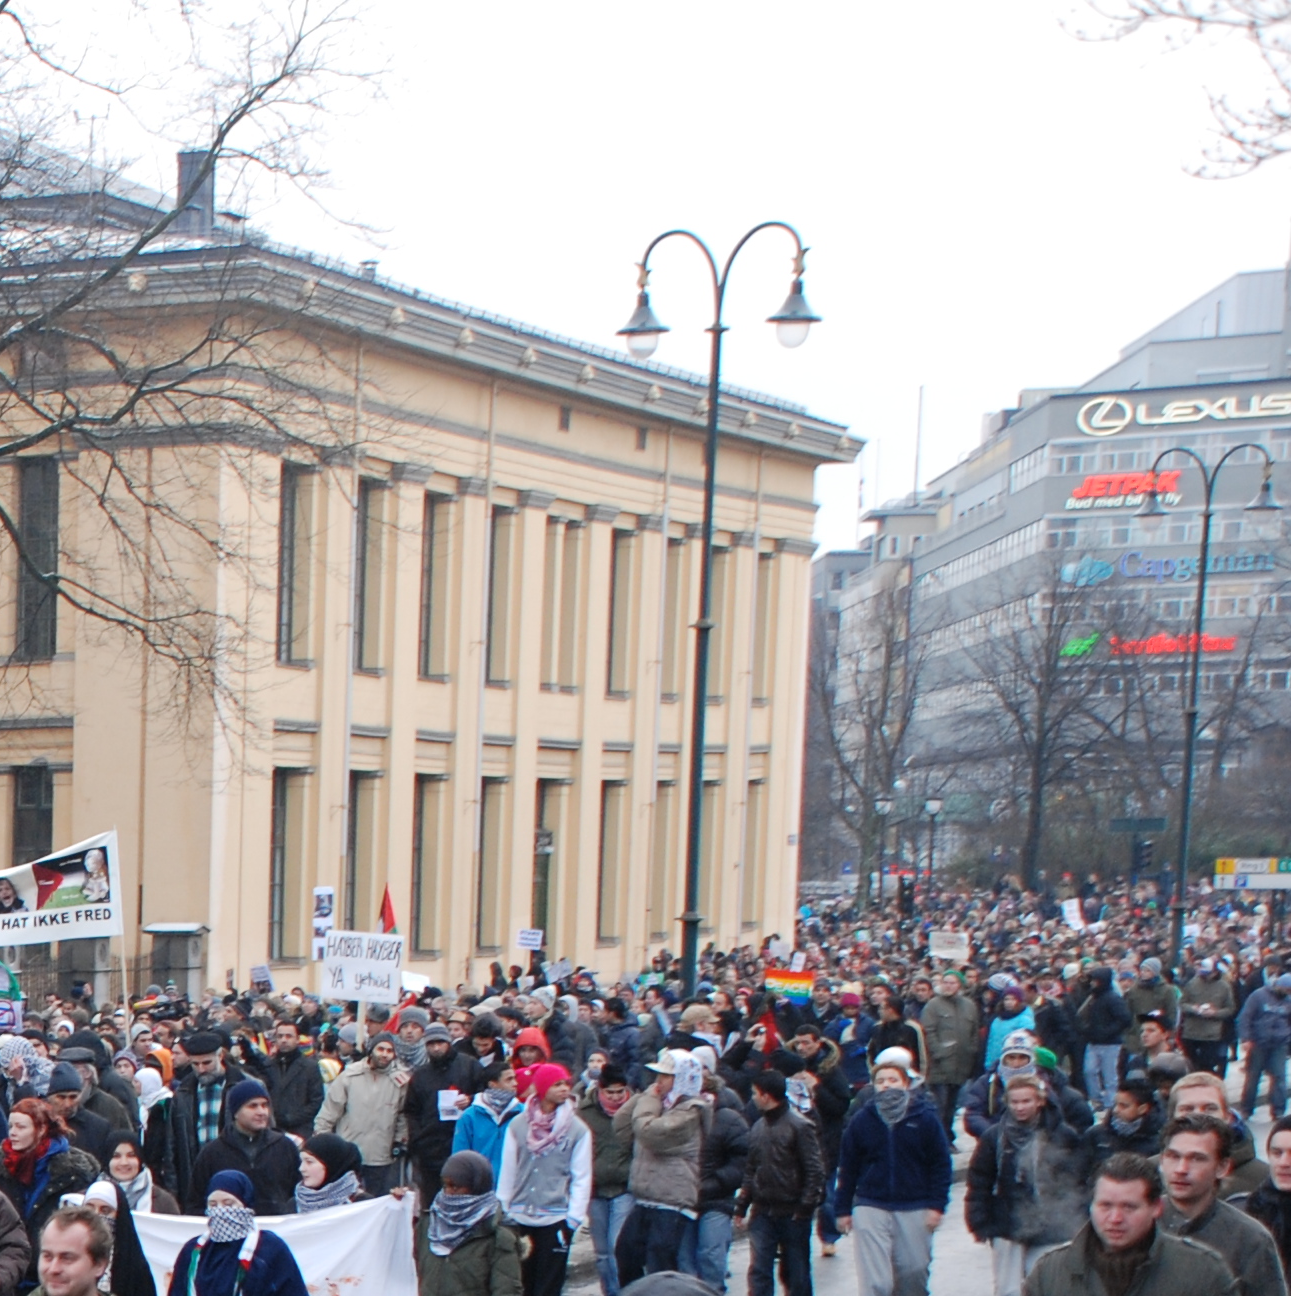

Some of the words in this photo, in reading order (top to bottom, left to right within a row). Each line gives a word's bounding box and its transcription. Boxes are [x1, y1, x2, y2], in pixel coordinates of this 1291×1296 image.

[1136, 393, 1291, 425] LEXUS
[1072, 469, 1181, 498] JETPAK
[1, 917, 28, 930] HAT
[33, 911, 70, 928] IKKE
[75, 908, 112, 923] FRED
